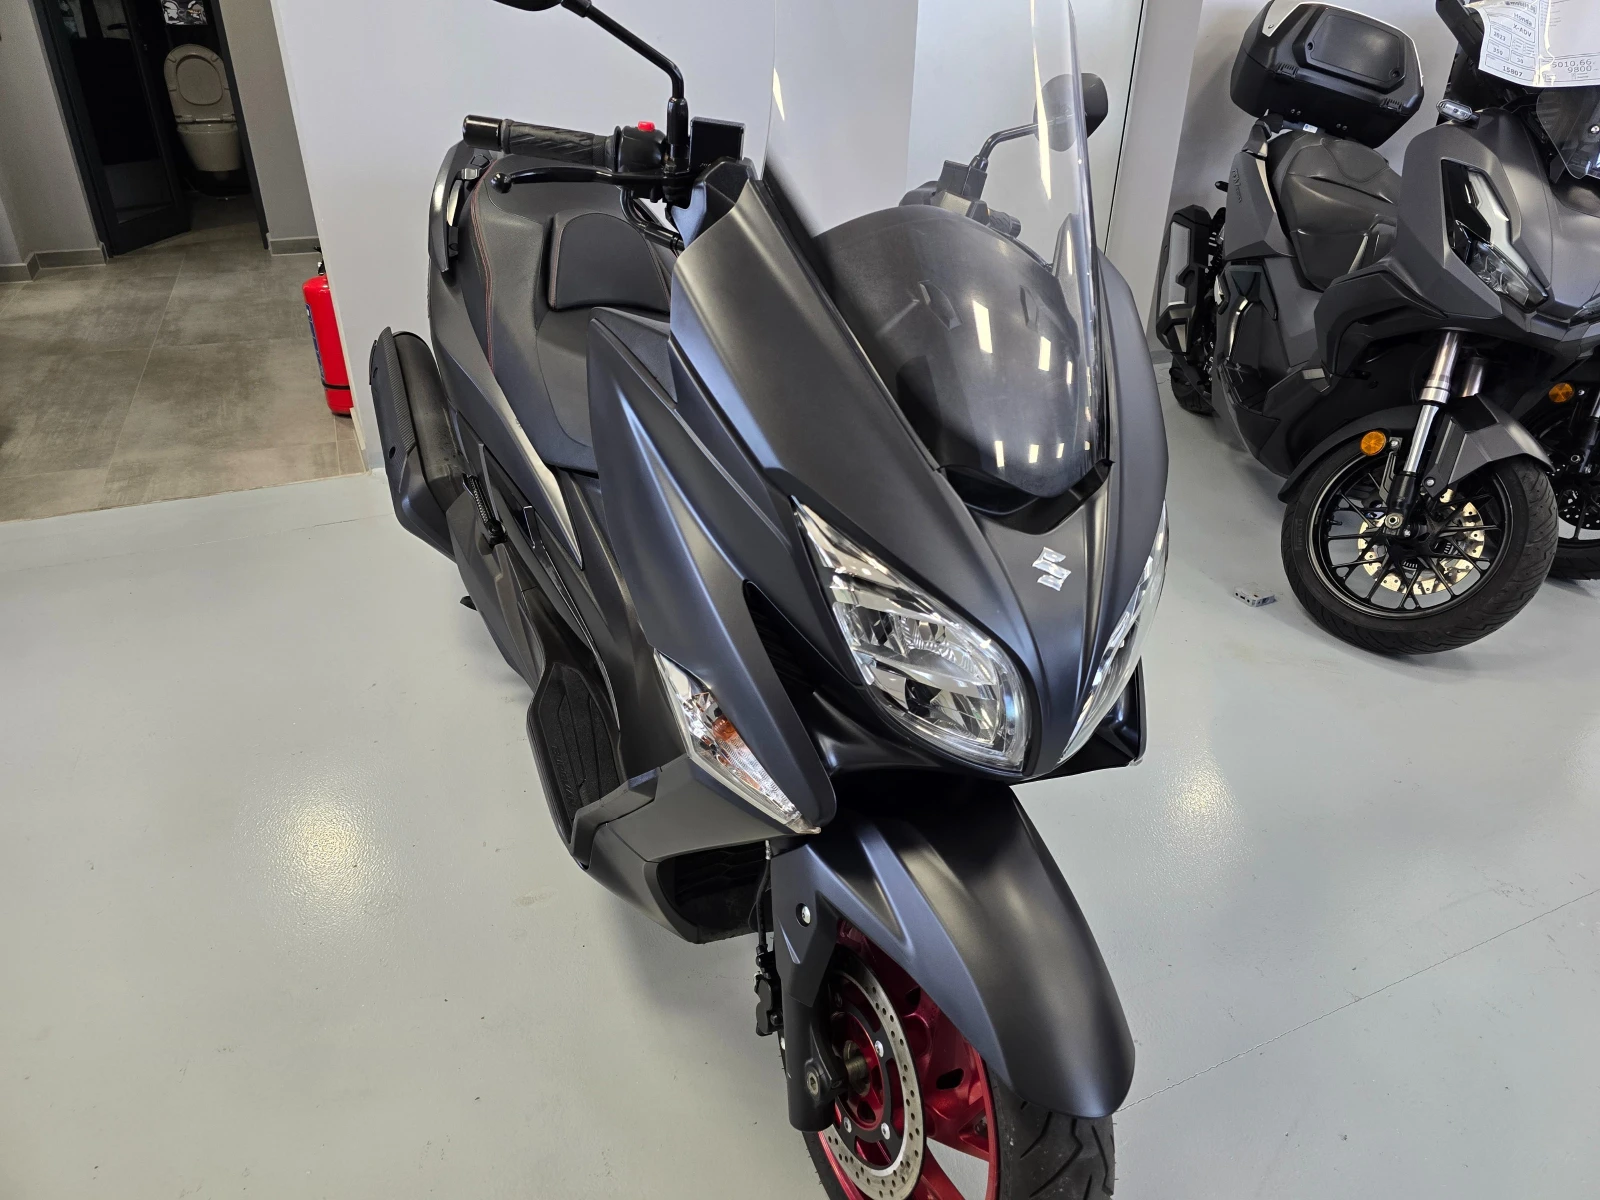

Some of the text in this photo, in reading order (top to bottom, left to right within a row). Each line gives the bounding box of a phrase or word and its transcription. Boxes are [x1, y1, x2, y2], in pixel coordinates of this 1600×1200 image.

[1513, 13, 1532, 27] Honda
[1513, 23, 1532, 37] X-ADV
[1502, 65, 1523, 77] 15807
[1567, 65, 1592, 74] 9800
